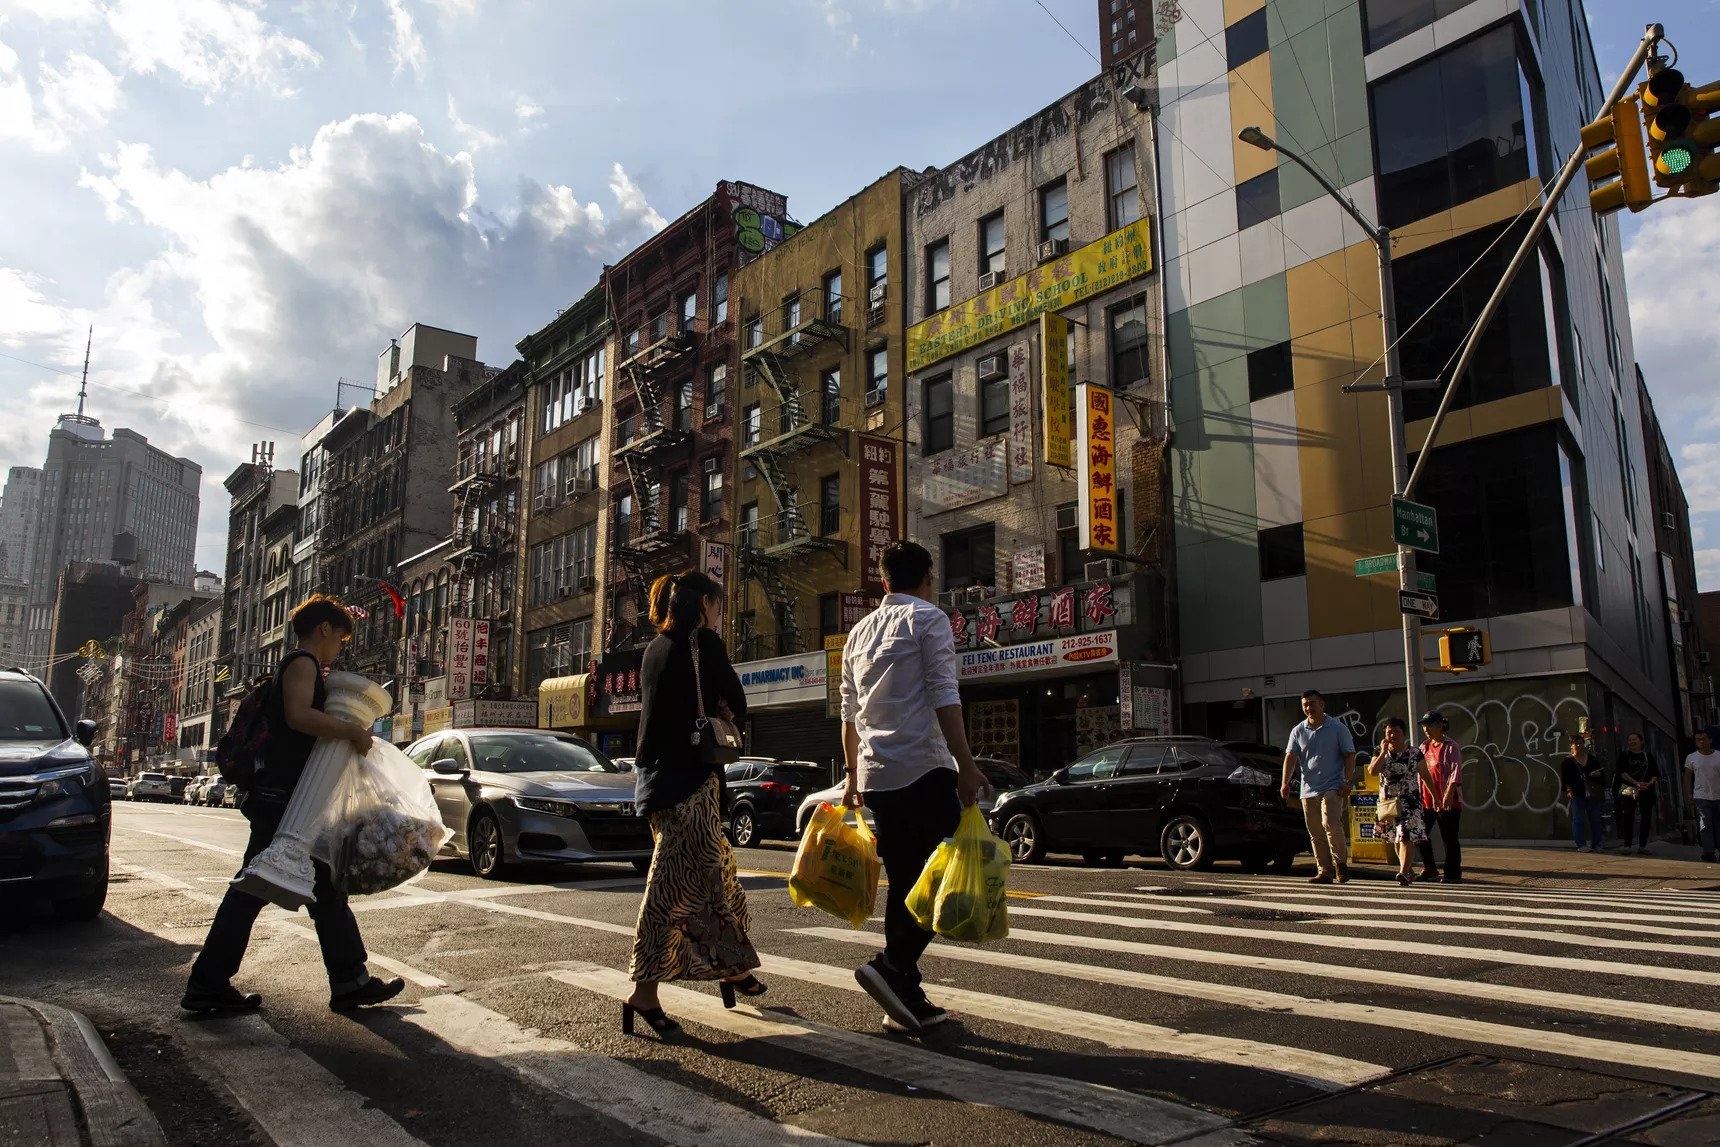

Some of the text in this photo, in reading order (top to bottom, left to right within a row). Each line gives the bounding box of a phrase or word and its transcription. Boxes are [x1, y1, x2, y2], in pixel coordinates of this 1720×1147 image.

[920, 323, 971, 354] EASTERN
[977, 297, 1030, 328] DRIVING
[1036, 272, 1089, 301] SCHOOL
[863, 444, 891, 464] 紐約
[1396, 506, 1433, 527] Manhattan
[1364, 555, 1397, 568] BROADWAY
[1403, 598, 1433, 610] ONE WAY
[1062, 633, 1112, 649] 212-925-1637
[963, 655, 974, 665] FEI
[999, 643, 1054, 661] RESTAURANT
[751, 667, 791, 684] PHARMACY
[791, 665, 804, 679] INC
